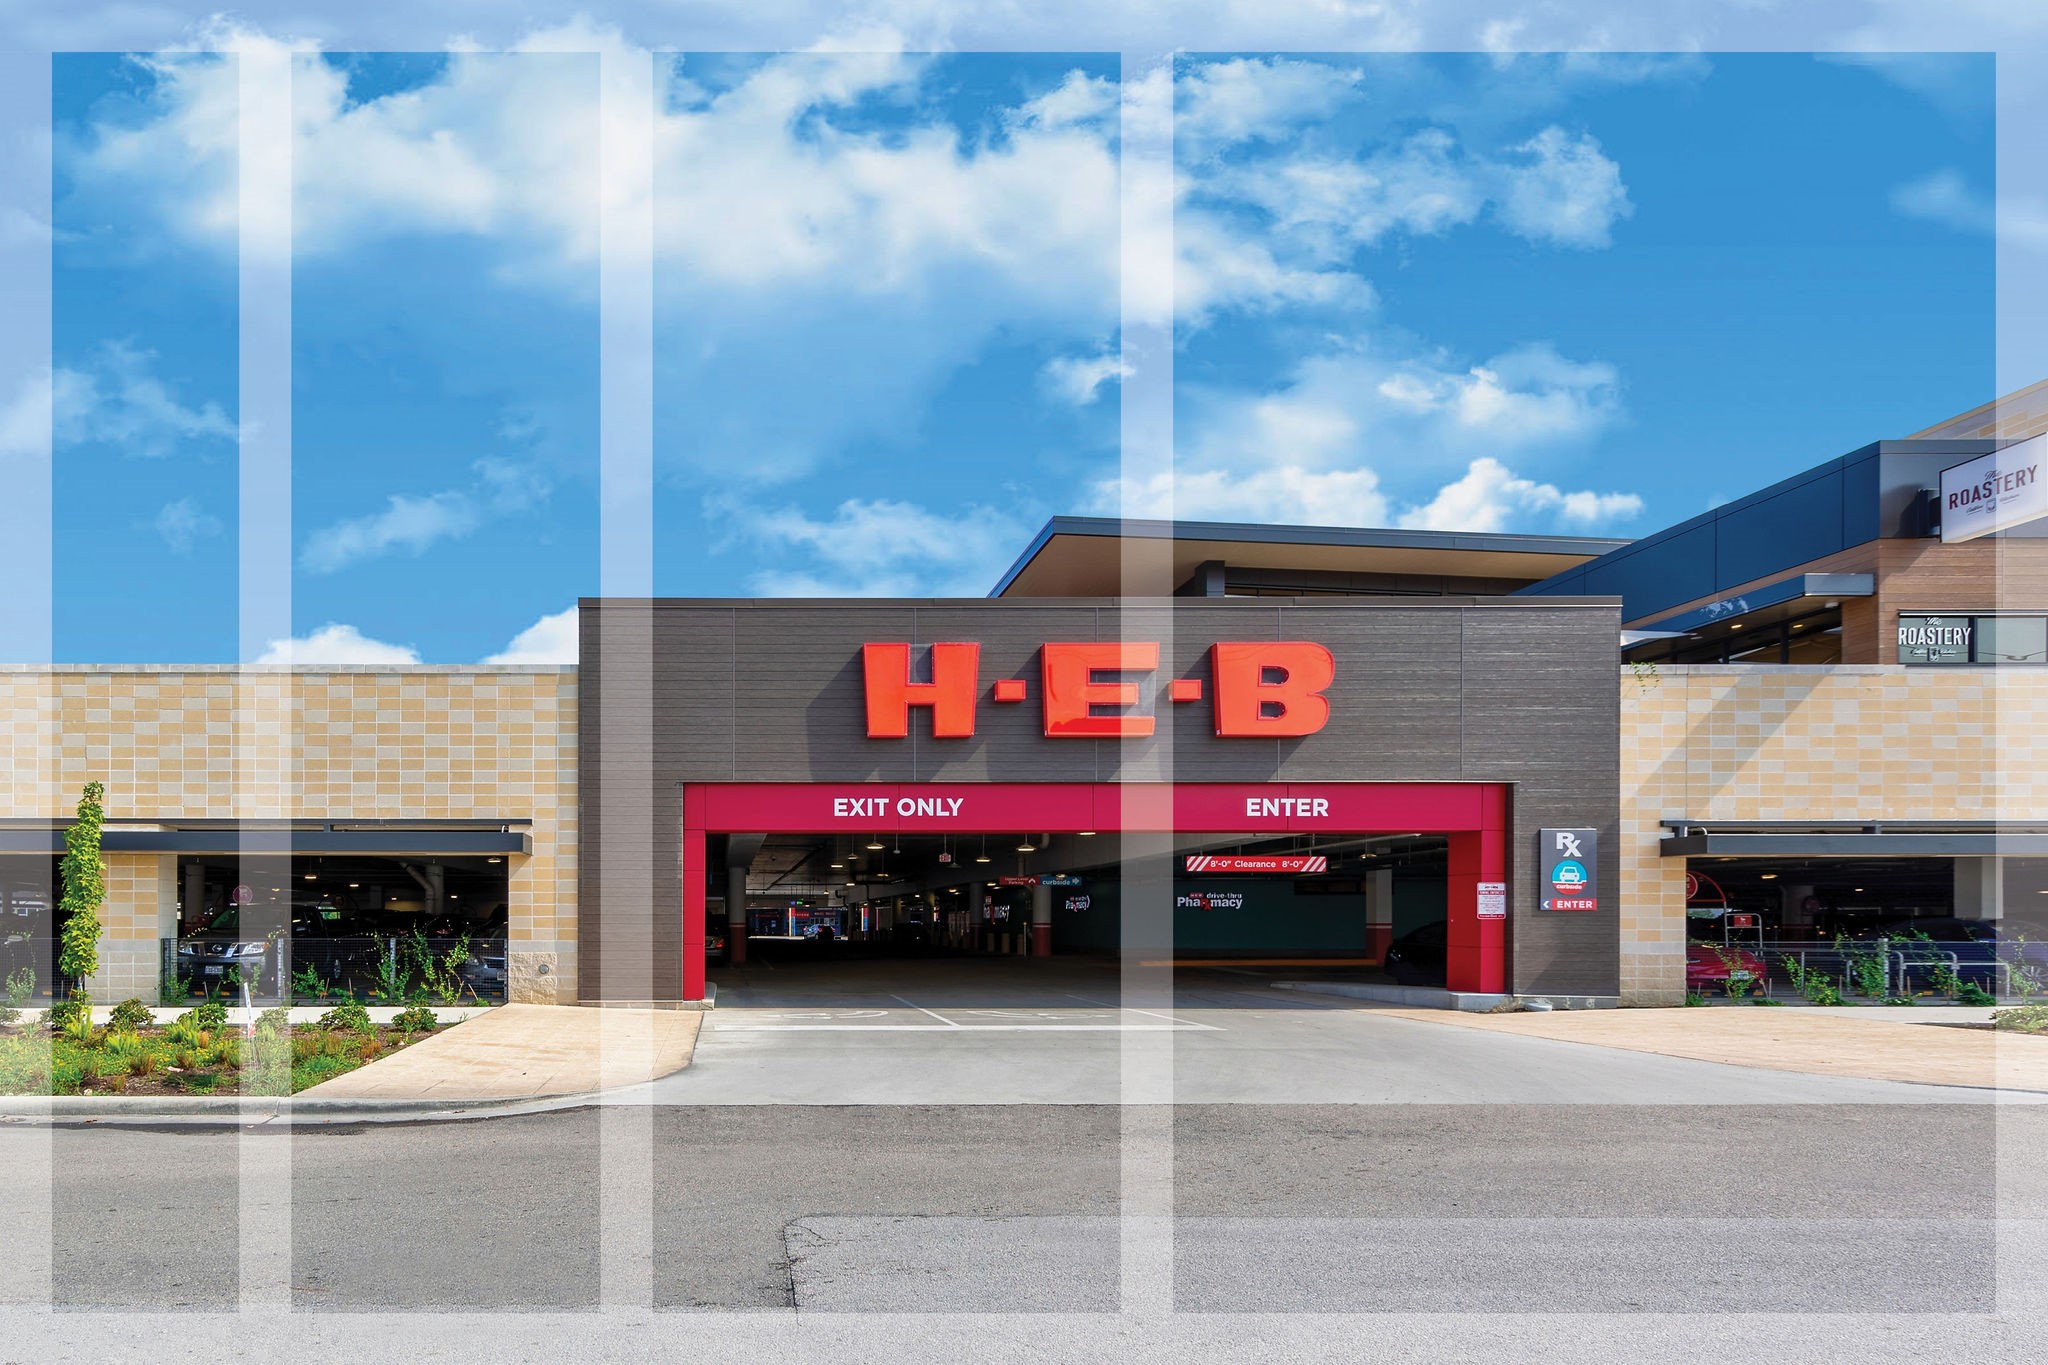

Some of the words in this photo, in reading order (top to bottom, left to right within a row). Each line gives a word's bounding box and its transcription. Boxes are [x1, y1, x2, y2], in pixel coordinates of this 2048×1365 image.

[1949, 465, 2038, 510] ROASTERY
[1898, 627, 1971, 645] ROASTERY
[863, 641, 1336, 738] H-E-B
[833, 798, 889, 817] EXIT
[896, 797, 964, 817] ONLY
[1246, 798, 1329, 817] ENTER
[1234, 860, 1276, 868] Clearance
[1557, 900, 1593, 909] ENTER
